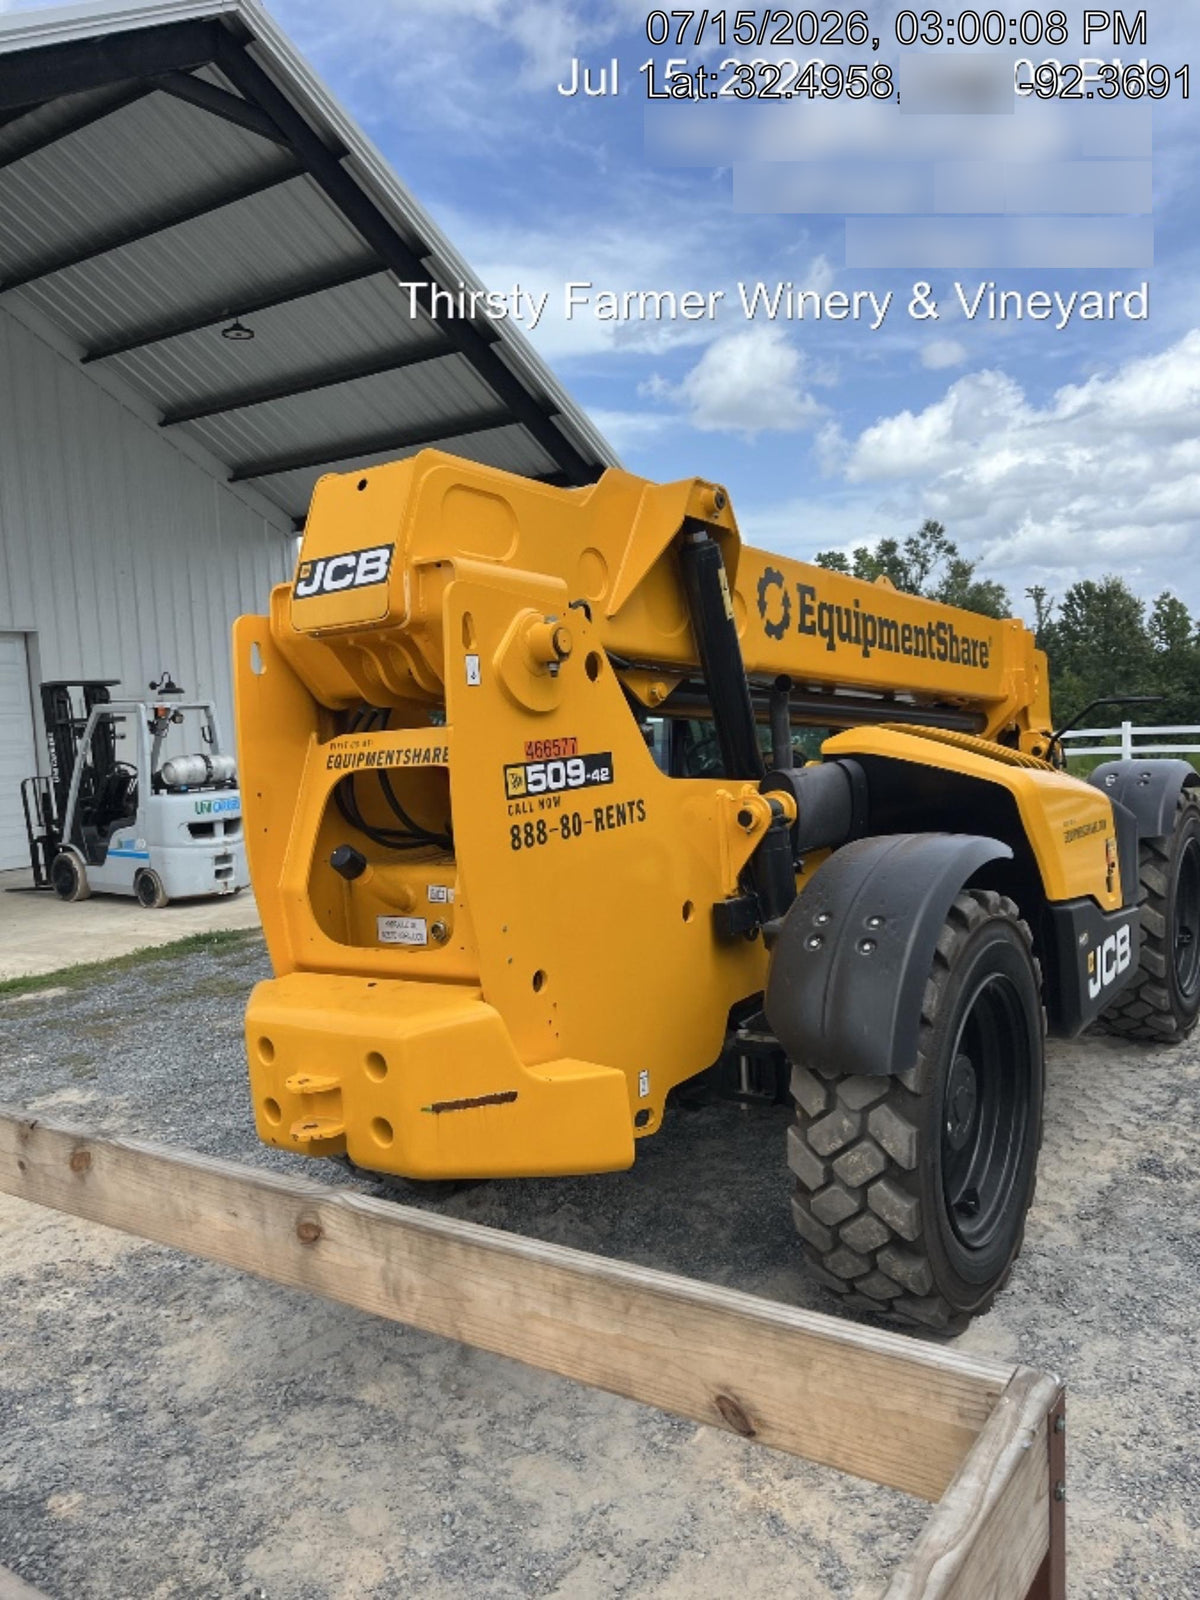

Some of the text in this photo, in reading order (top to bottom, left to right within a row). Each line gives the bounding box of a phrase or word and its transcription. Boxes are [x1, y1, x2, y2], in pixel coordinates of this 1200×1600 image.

[296, 548, 390, 597] JCB
[796, 583, 990, 669] EquipmentShare
[326, 746, 449, 770] EQUIPMENTSHARE
[525, 737, 577, 760] 466577
[507, 796, 562, 817] CALL NOW
[510, 798, 646, 851] 888-80-RENTS
[1088, 923, 1132, 999] JCB
